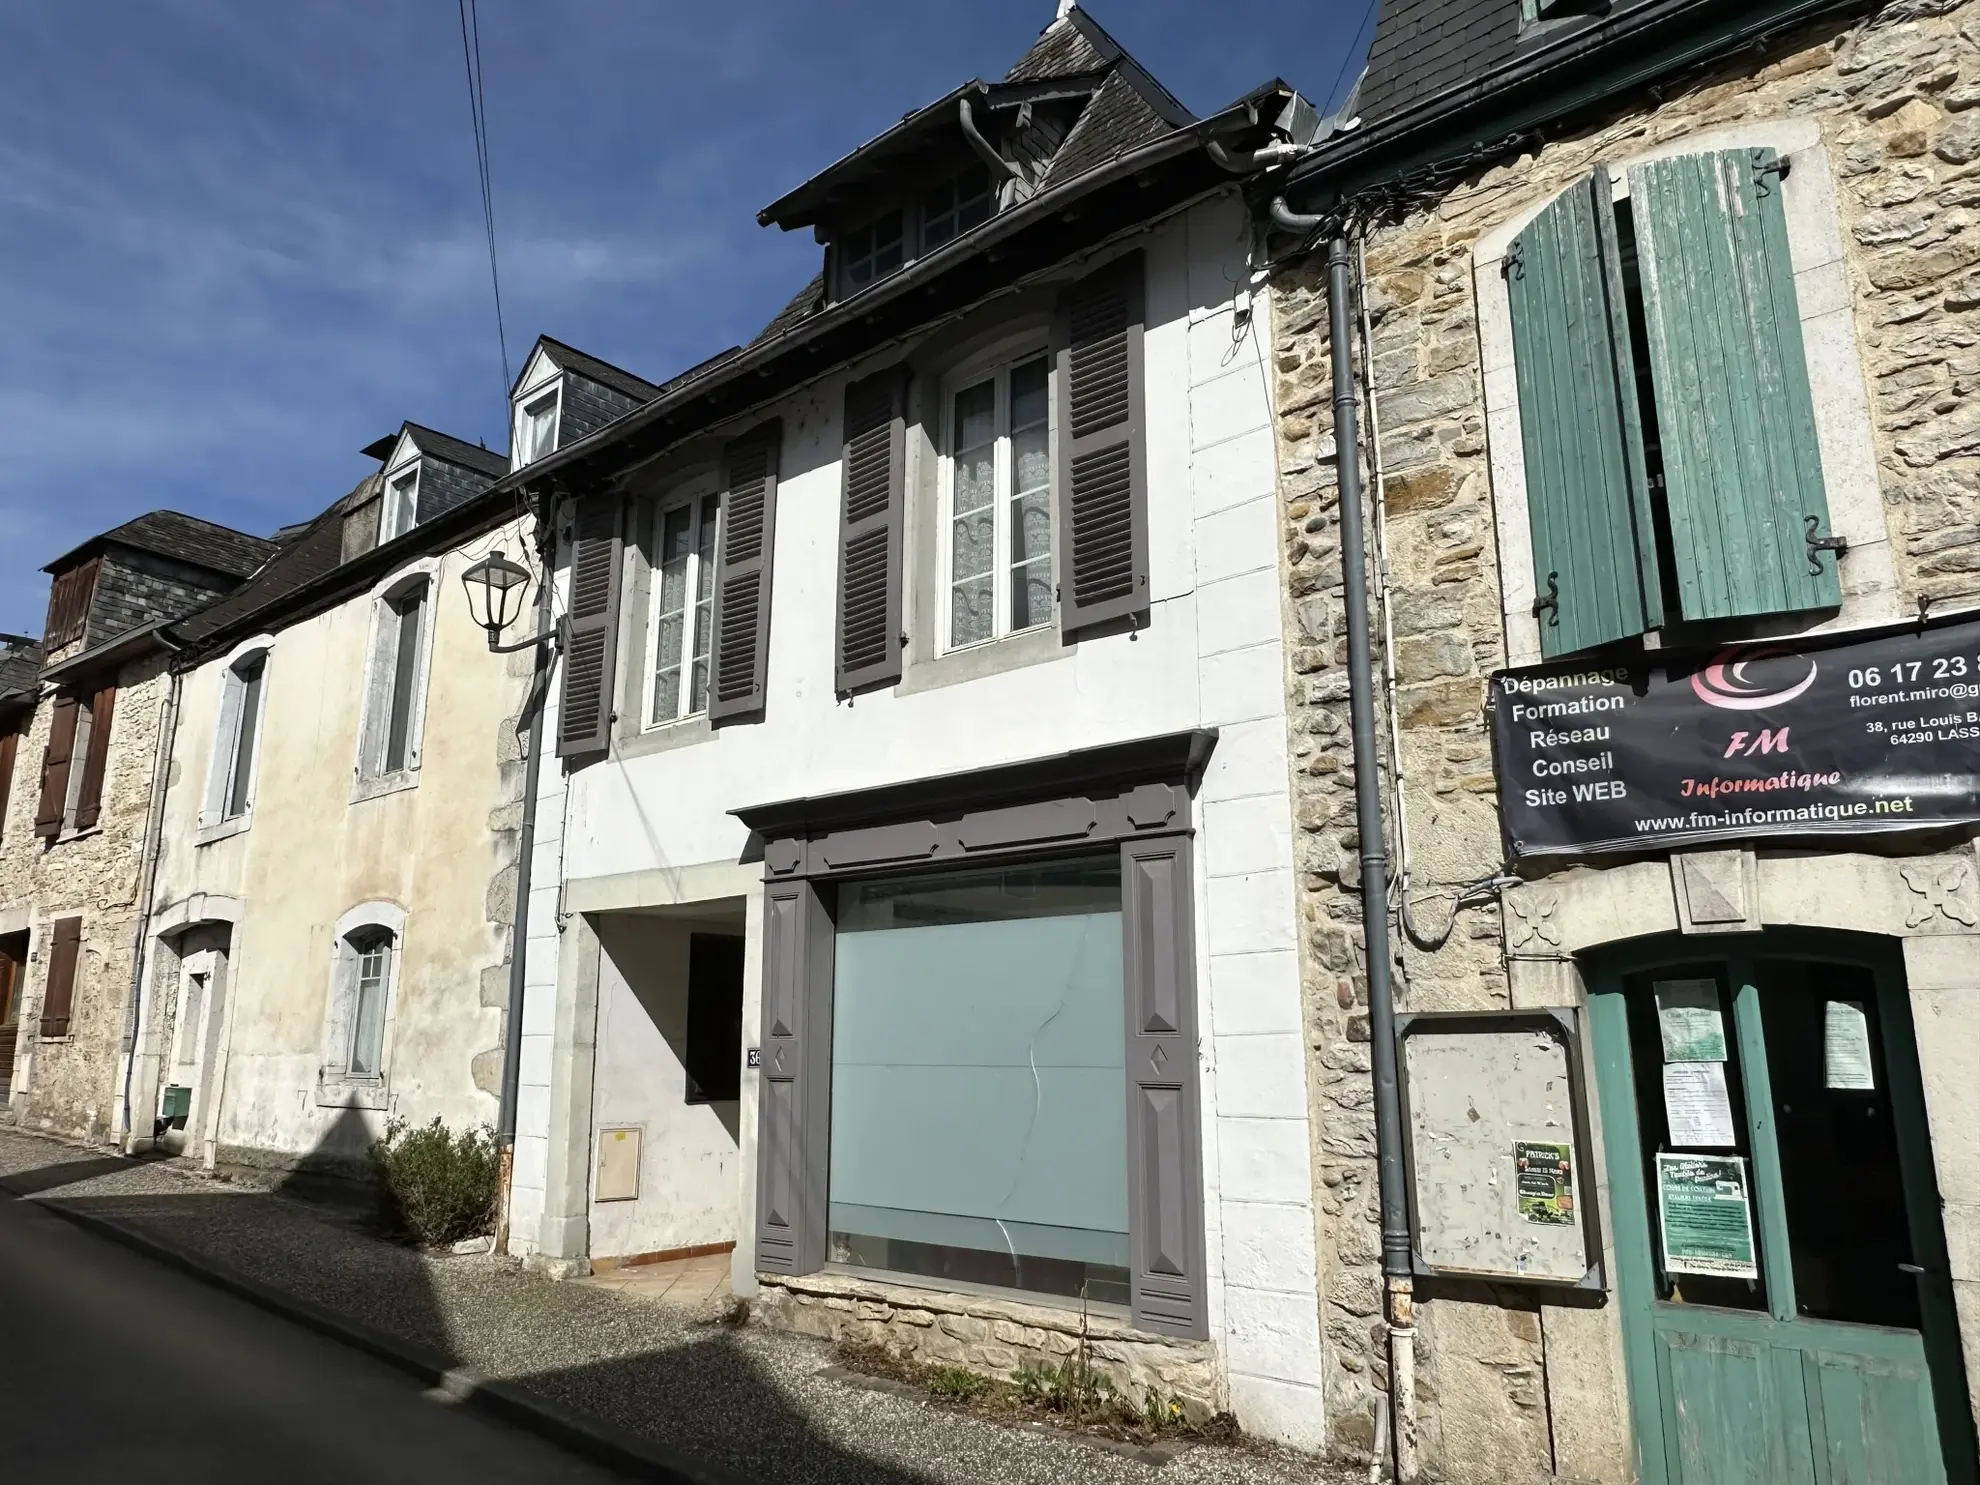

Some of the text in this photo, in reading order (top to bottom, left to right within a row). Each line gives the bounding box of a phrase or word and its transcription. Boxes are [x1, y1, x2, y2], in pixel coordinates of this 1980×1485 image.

[1503, 667, 1629, 695] Dépannage
[1848, 667, 1881, 688] 06
[1890, 661, 1922, 683] 17
[1932, 656, 1968, 679] 23
[1512, 695, 1625, 722] Formation
[1849, 683, 1980, 707] florent.miro@g
[1866, 711, 1980, 733] 38, rue Louis B
[1890, 726, 1980, 745] 64290 LASS
[1530, 726, 1610, 749] Réseau
[1723, 726, 1790, 759] FM
[1532, 751, 1613, 777] Conseil
[1525, 780, 1627, 807] Site WEB
[1680, 770, 1841, 799] Informatique
[1634, 796, 1914, 832] www.fm-informatique.net
